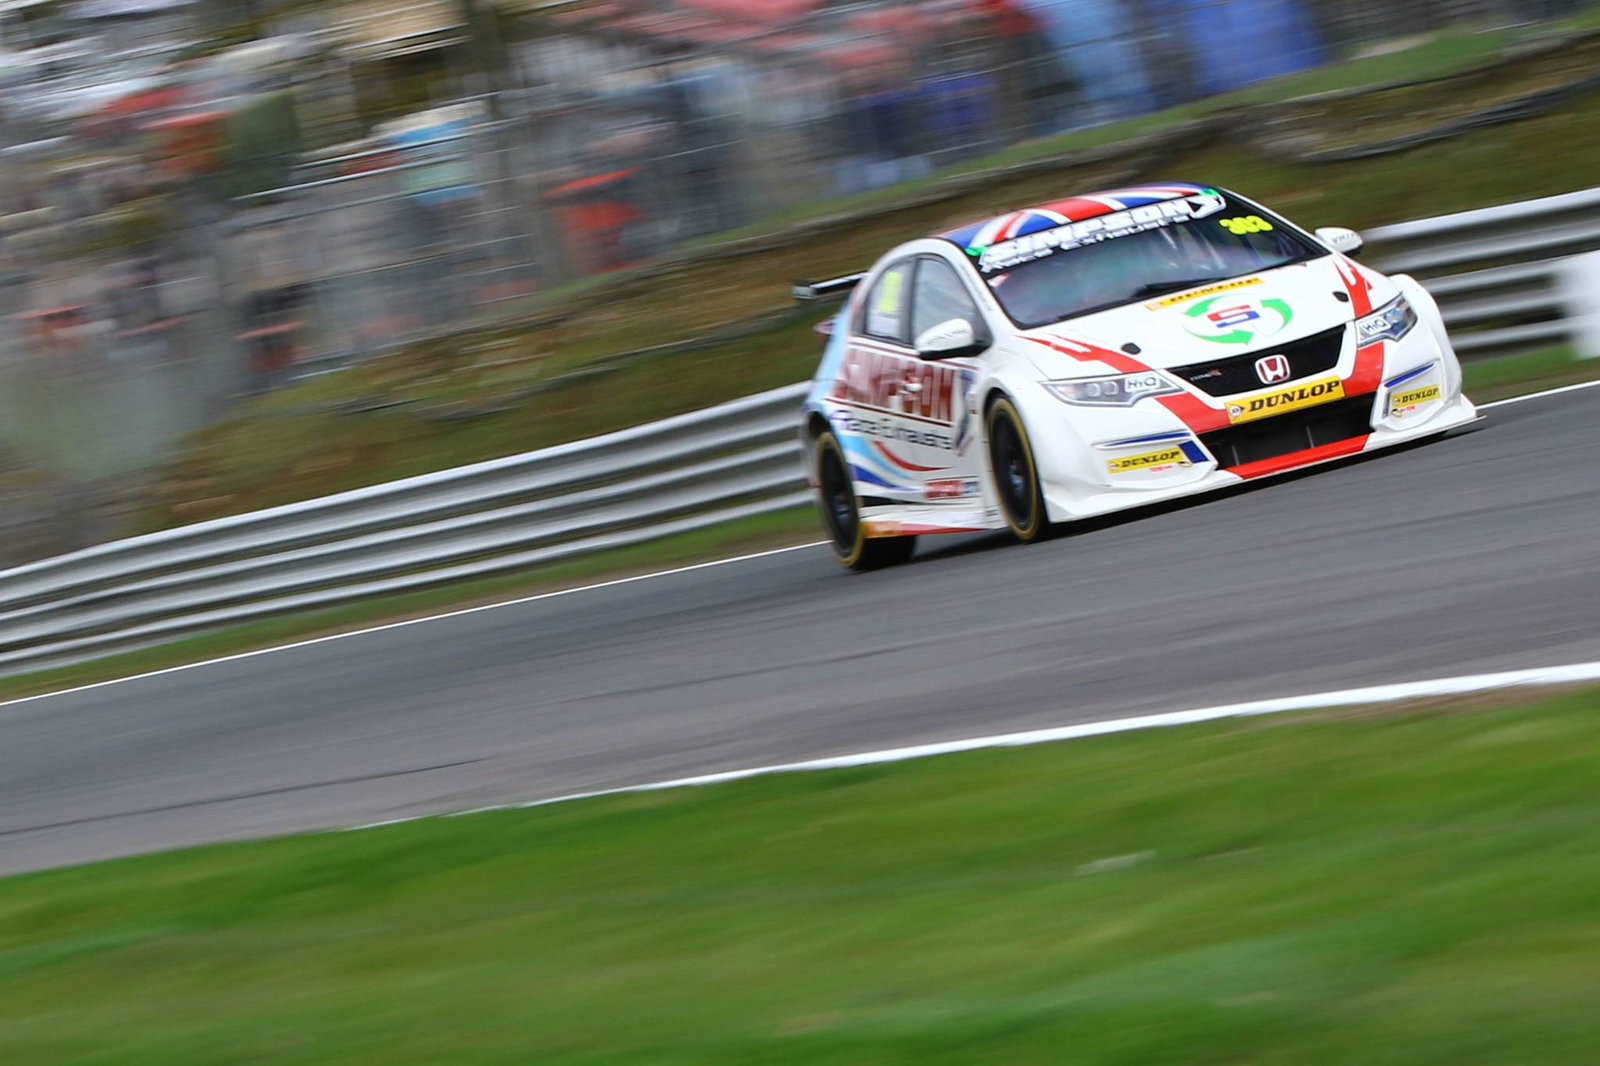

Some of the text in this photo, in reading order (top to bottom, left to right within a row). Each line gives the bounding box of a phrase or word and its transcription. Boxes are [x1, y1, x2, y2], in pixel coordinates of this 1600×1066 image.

[979, 197, 1191, 265] SIMPSON
[1248, 379, 1340, 413] DUNLOP
[1401, 387, 1439, 403] DUNLOP
[1122, 451, 1180, 468] DUNLOP
